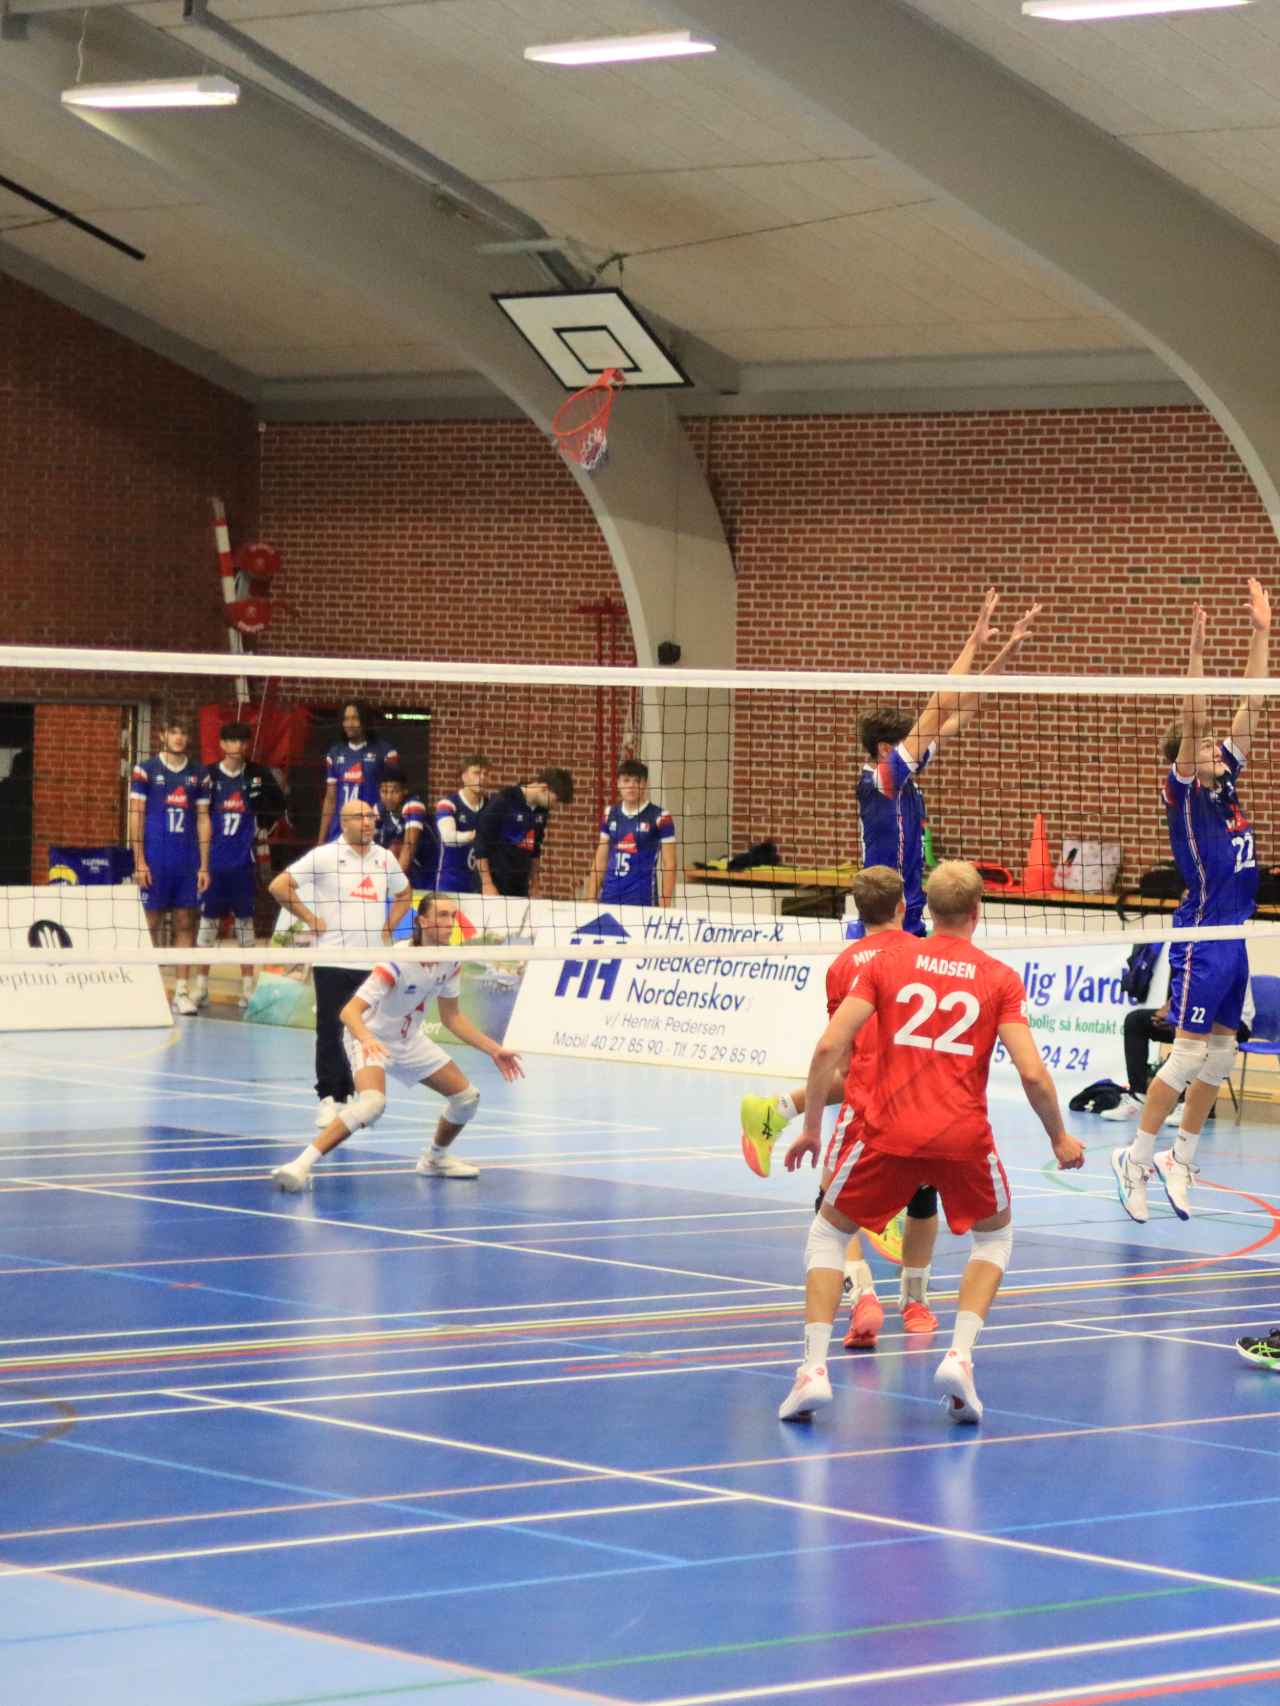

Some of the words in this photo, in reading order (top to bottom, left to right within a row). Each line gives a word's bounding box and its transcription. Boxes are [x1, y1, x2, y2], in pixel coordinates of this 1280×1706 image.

[167, 808, 184, 832] 12
[223, 812, 242, 836] 17
[615, 852, 630, 876] 15
[1231, 833, 1255, 874] 22
[643, 915, 684, 941] H.H.
[0, 969, 57, 992] eptun
[65, 966, 134, 991] apotek
[915, 954, 976, 979] MADSEN
[626, 977, 746, 1011] Nordenskov
[1024, 962, 1056, 1006] lig
[622, 1013, 661, 1031] Henrik
[664, 1016, 726, 1036] Pedersen
[893, 982, 980, 1056] 22
[1075, 1017, 1117, 1034] kontakt
[1190, 1006, 1206, 1024] 22
[552, 1031, 589, 1048] Mobil
[749, 1049, 767, 1065] 90
[1066, 1047, 1090, 1071] 24
